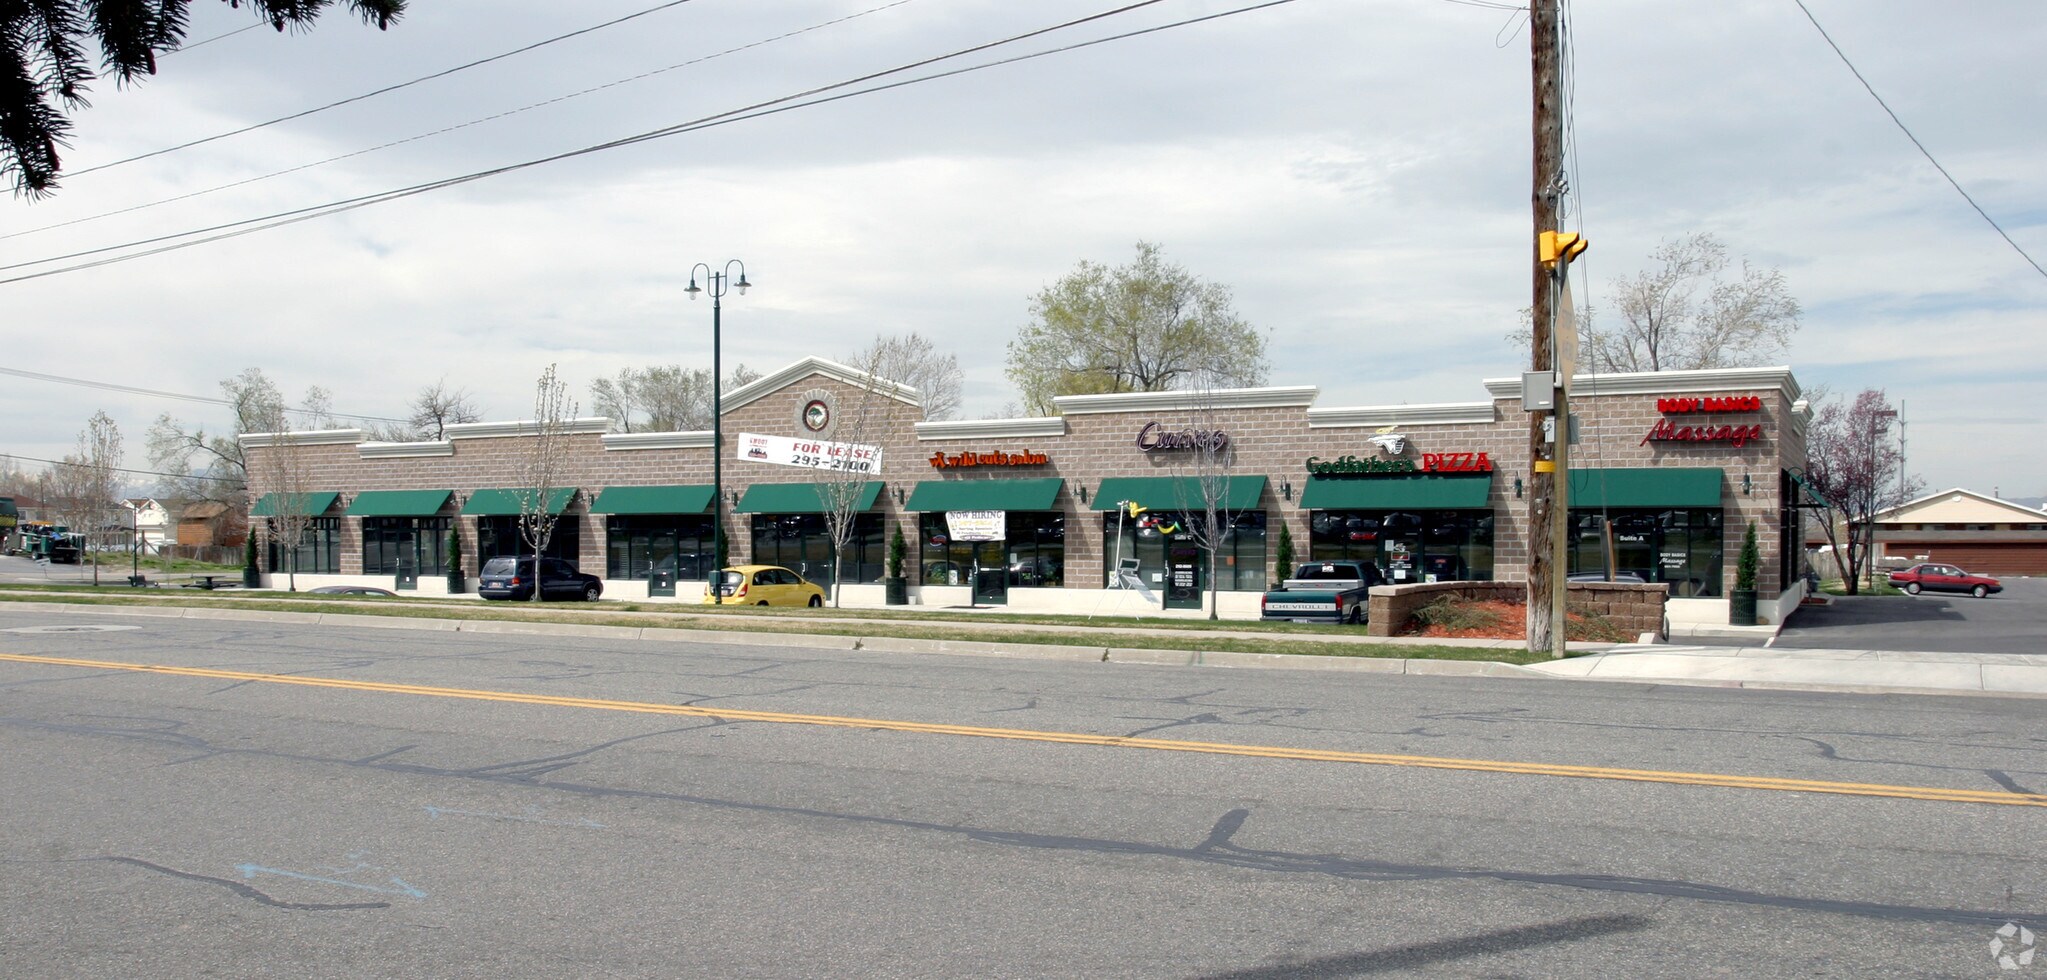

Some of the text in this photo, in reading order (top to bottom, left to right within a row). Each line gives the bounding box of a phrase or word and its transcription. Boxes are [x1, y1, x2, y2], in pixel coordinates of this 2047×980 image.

[1657, 396, 1760, 412] BODY BASICS
[1136, 421, 1228, 452] Curves
[1639, 418, 1761, 448] Massage
[792, 442, 873, 459] FOR LEASE
[978, 450, 1008, 465] cuts
[1009, 449, 1048, 465] salon
[1306, 452, 1492, 474] Godfather's PIZZA
[950, 511, 1003, 519] NOW HIRING
[1659, 557, 1686, 565] Massage
